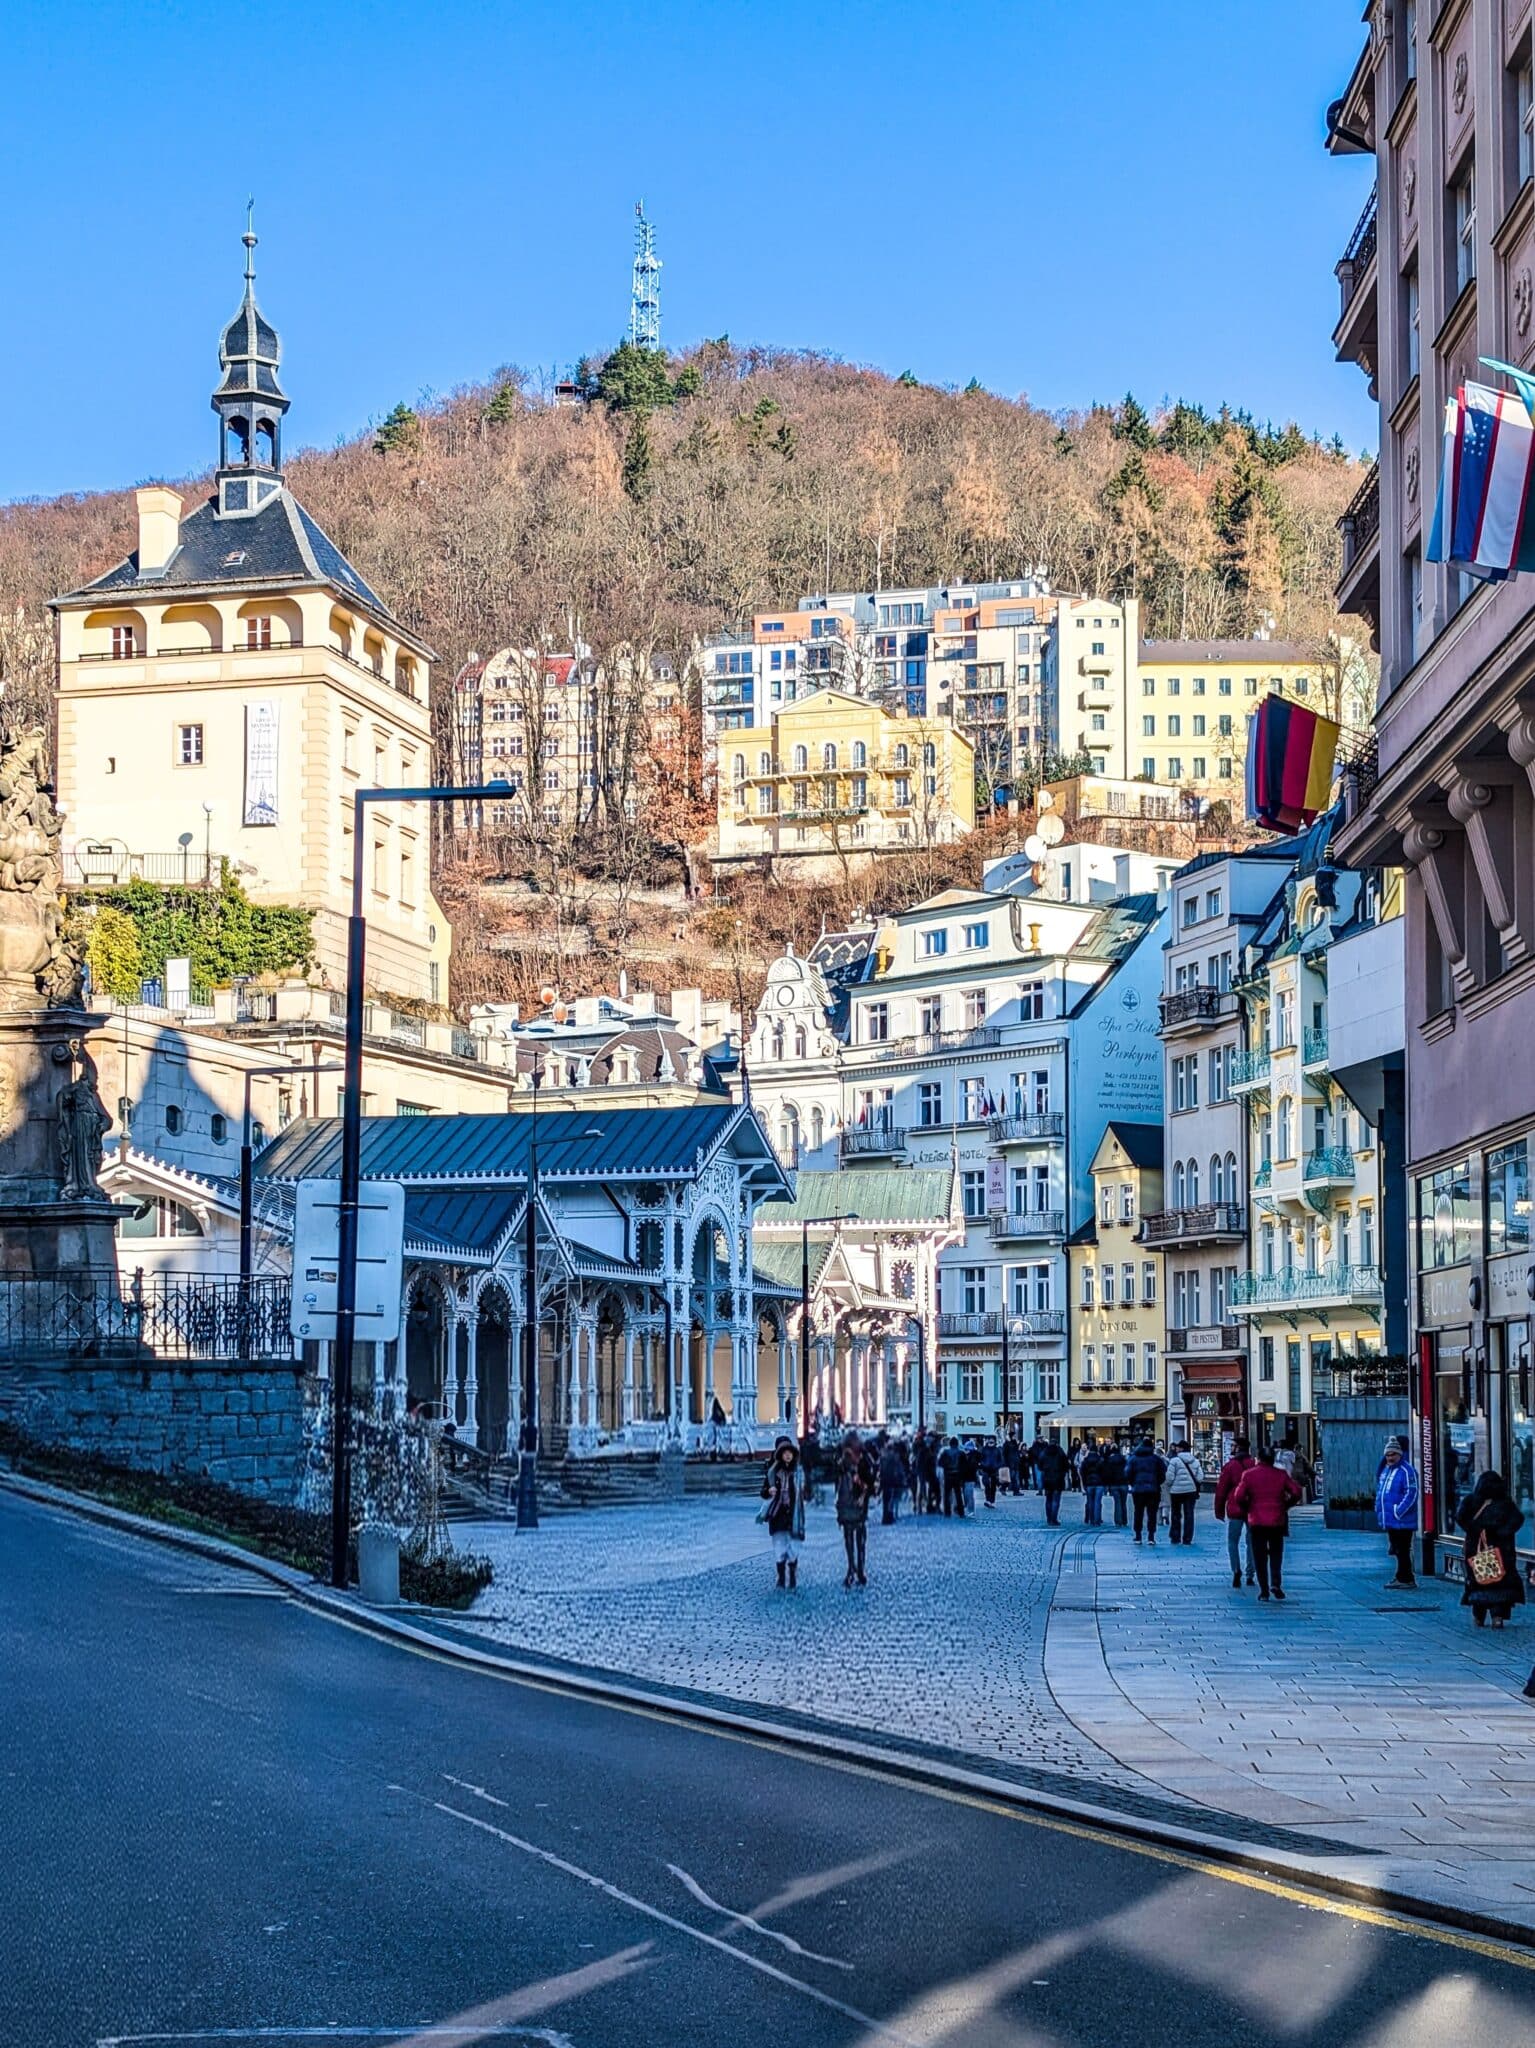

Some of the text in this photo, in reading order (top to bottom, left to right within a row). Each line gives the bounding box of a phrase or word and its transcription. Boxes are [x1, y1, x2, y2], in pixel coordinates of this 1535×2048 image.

[1099, 1016, 1160, 1036] Spa Hotel
[1102, 1040, 1159, 1067] Purkyně
[913, 1150, 985, 1163] LÁZEŇSK HOTEL
[1122, 1320, 1138, 1332] OREL
[1423, 1418, 1433, 1495] SPRAYGROUND
